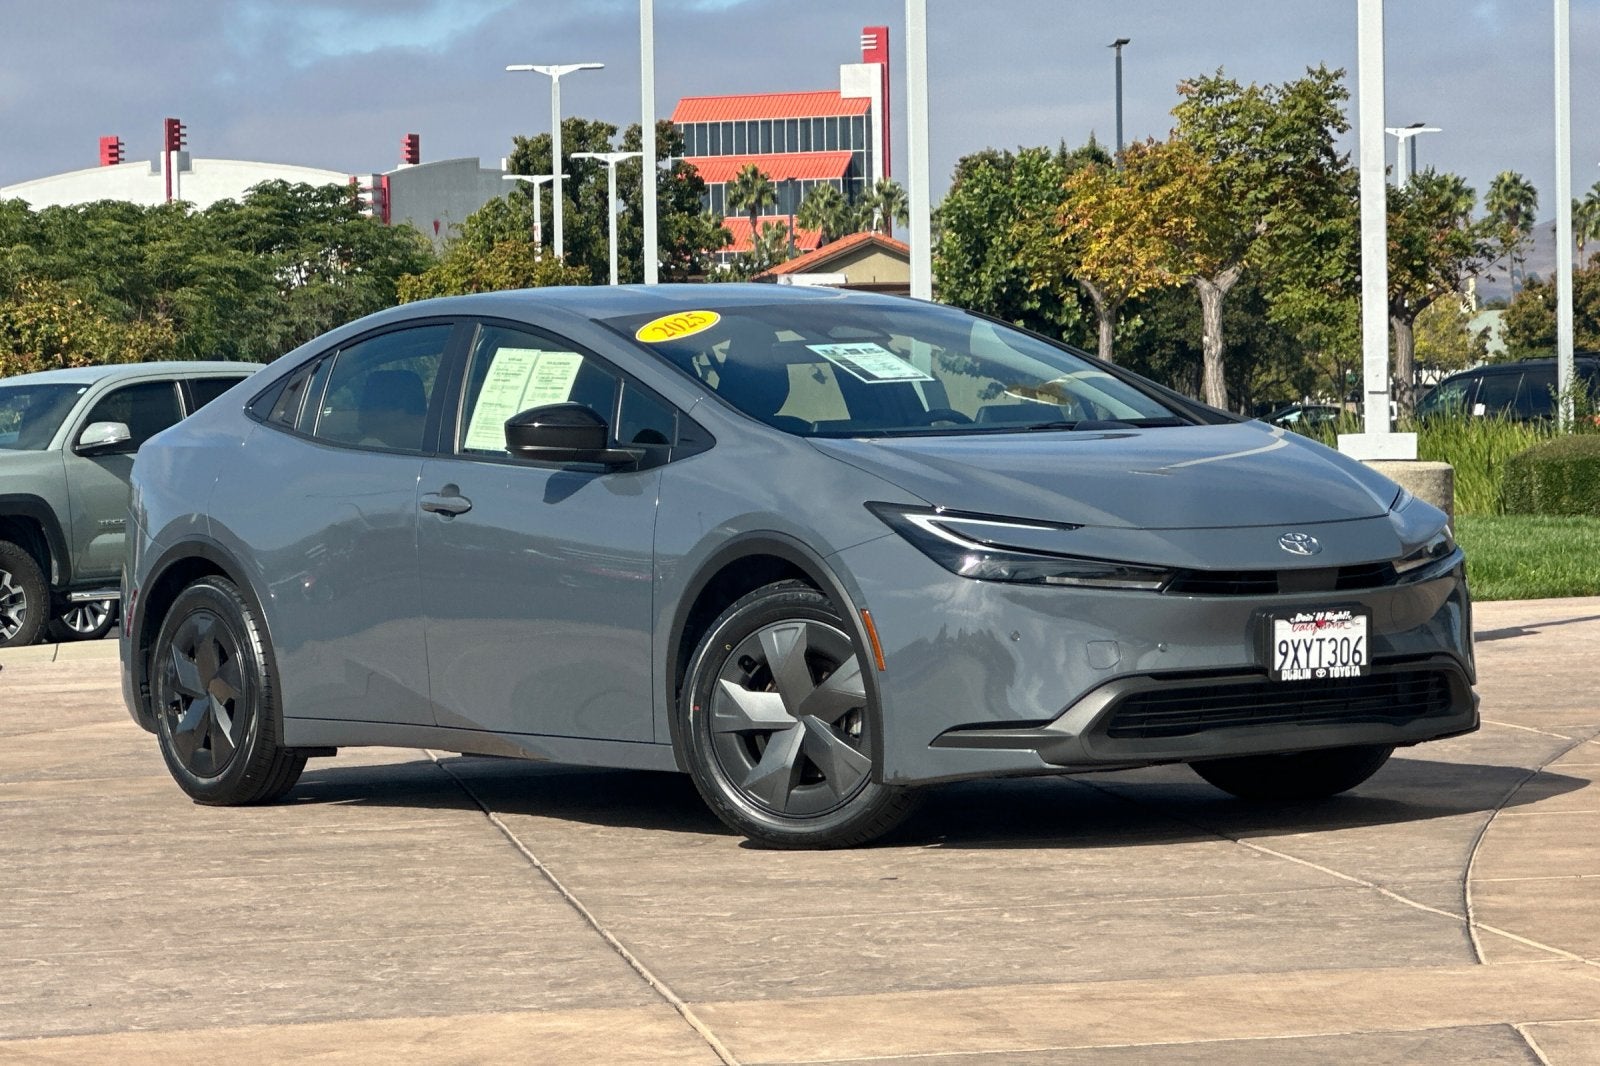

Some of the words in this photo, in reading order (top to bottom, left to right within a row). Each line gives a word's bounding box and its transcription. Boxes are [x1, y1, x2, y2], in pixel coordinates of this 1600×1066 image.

[652, 313, 707, 338] 2025
[1291, 621, 1351, 636] Califrnia
[1278, 635, 1363, 671] 9XYT306
[1281, 668, 1312, 681] DUBLIN
[1329, 666, 1361, 678] TOYOTA
